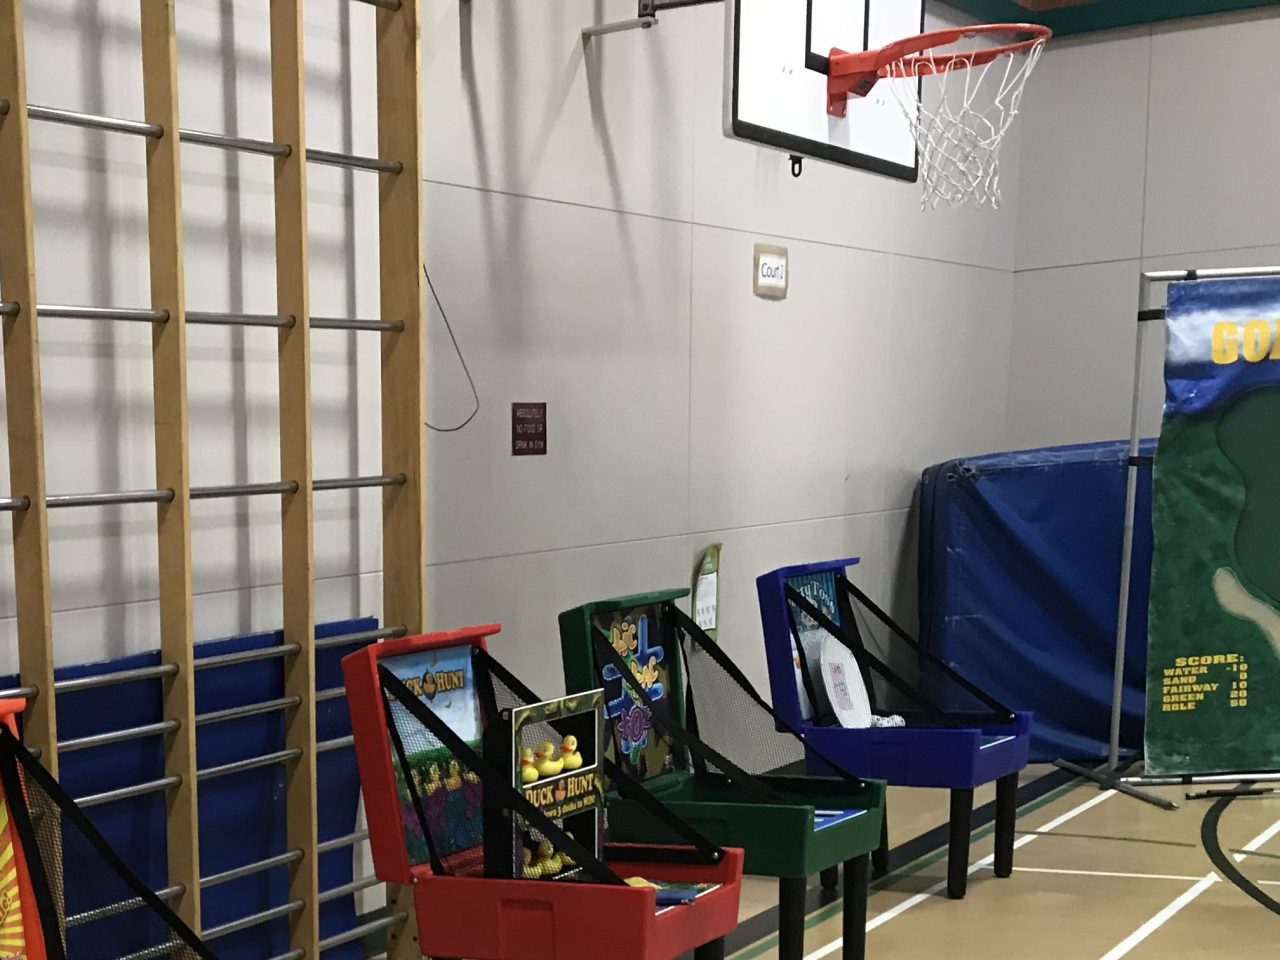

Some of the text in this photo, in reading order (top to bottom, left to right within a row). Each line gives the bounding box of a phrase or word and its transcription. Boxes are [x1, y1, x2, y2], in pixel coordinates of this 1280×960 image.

[761, 262, 780, 278] Court
[1163, 666, 1208, 676] WATER
[435, 669, 465, 693] HUNT
[1163, 675, 1197, 685] SAND
[1163, 681, 1248, 694] FAIRWAY 10
[1162, 689, 1248, 703] GREEN 20
[1162, 701, 1196, 712] HOLE
[567, 773, 594, 798] HUNT
